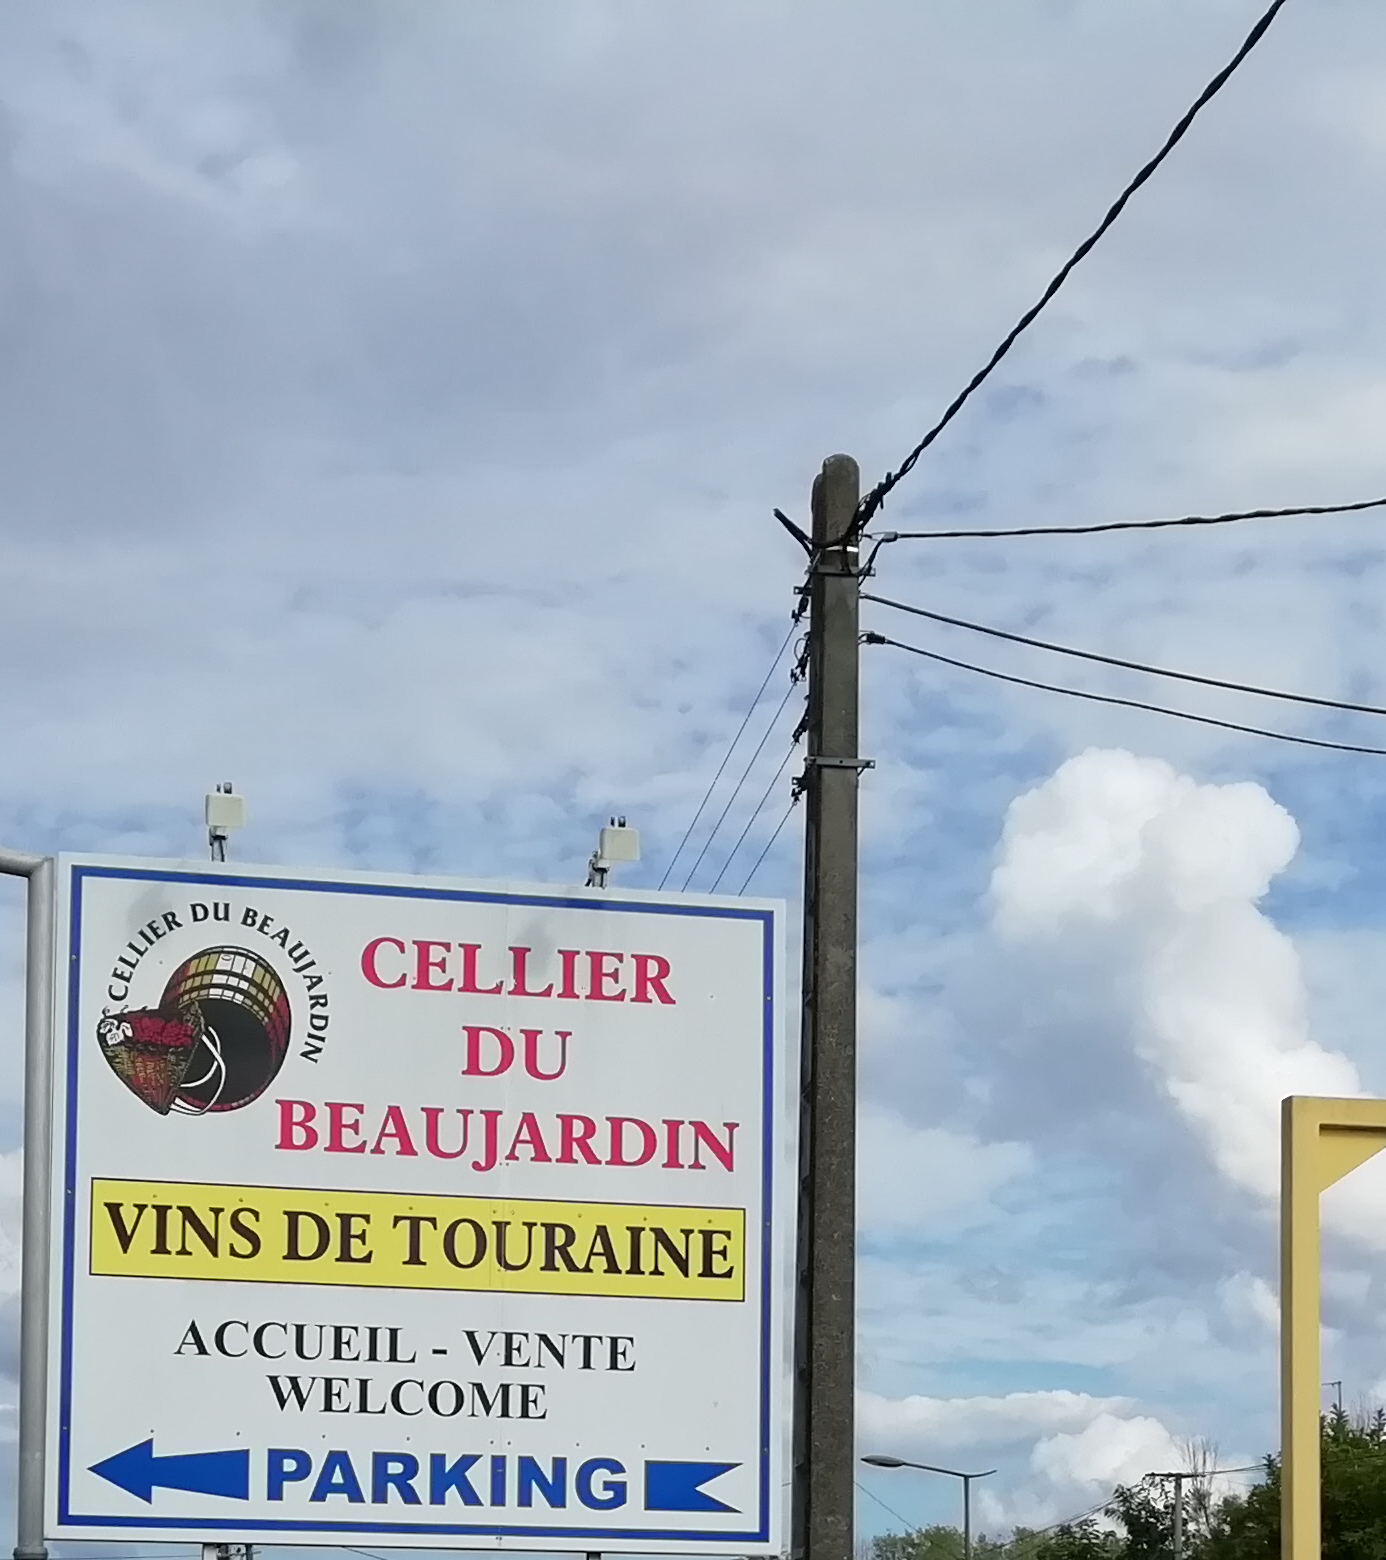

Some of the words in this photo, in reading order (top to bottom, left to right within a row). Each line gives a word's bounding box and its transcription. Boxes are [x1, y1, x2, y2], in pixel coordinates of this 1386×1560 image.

[108, 910, 184, 1002] CELLIER
[190, 902, 231, 923] DU
[240, 906, 330, 1064] BEAUJARDIN
[360, 936, 676, 1005] CELLIER
[461, 1025, 572, 1082] DU
[274, 1099, 740, 1174] BEAUJARDIN
[103, 1201, 262, 1261] VINS
[282, 1210, 375, 1265] DE
[393, 1215, 735, 1280] TOURAINE
[173, 1319, 417, 1365] ACCUEIL
[463, 1329, 637, 1373] VENTE
[266, 1374, 548, 1420] WELCOME
[266, 1448, 628, 1511] PARKING
